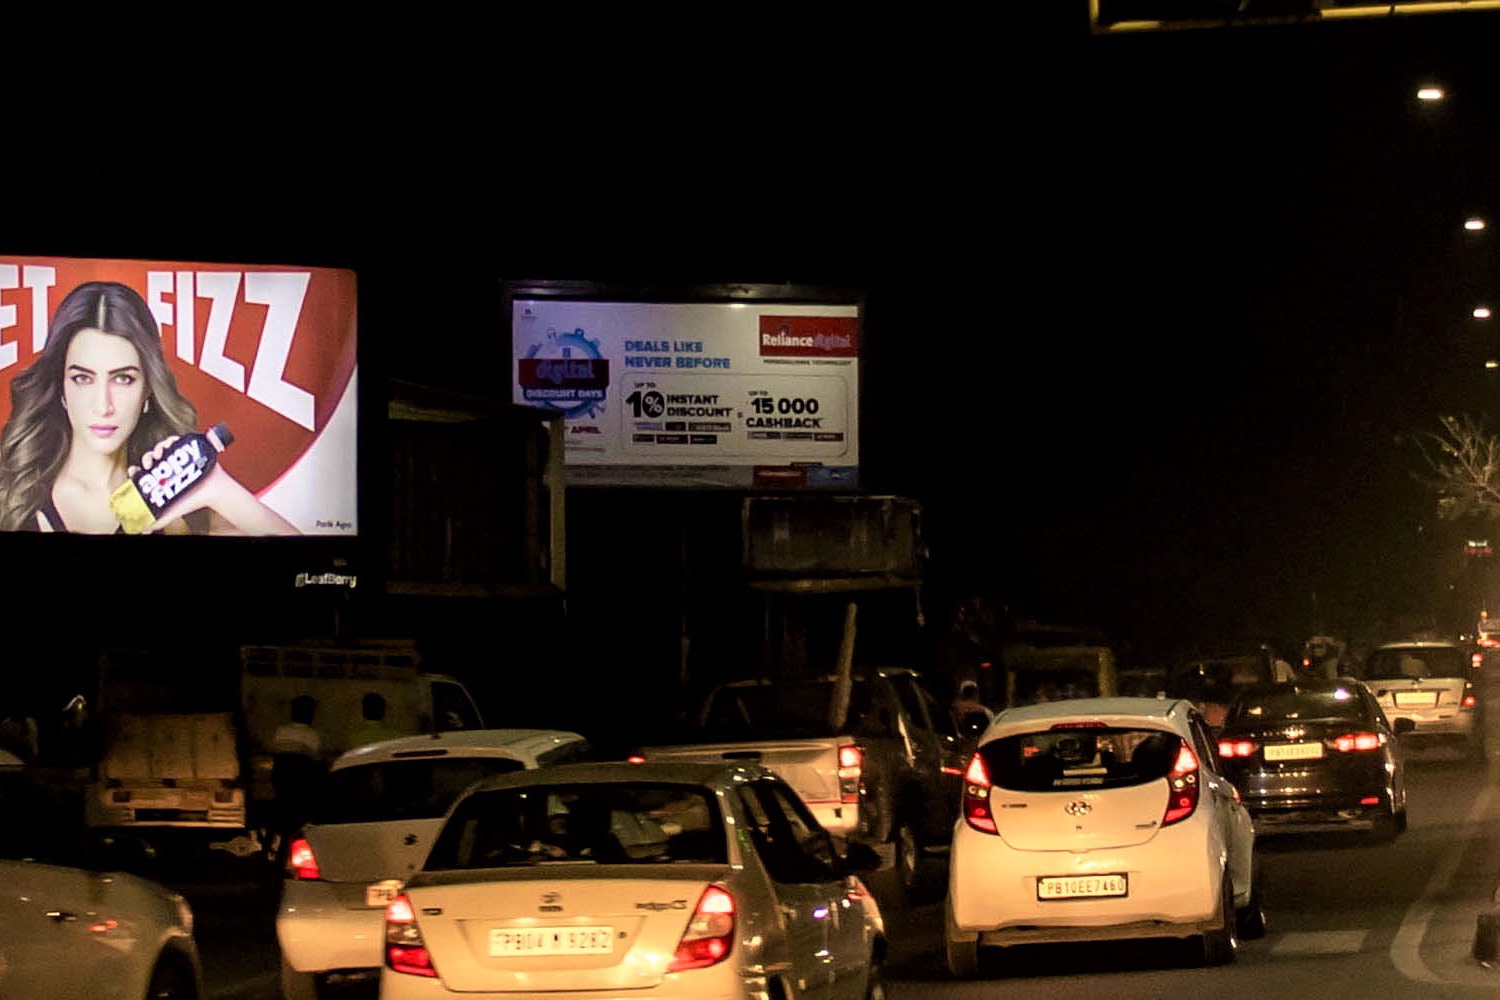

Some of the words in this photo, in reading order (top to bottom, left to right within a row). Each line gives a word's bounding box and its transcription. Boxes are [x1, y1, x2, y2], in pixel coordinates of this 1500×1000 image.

[146, 271, 316, 433] FIZZ
[625, 340, 670, 352] DEALS
[674, 341, 703, 352] LIKE
[625, 356, 672, 368] NEVER
[675, 357, 731, 369] BEFORE
[578, 389, 603, 398] DAYS
[667, 394, 719, 404] INSTANT
[139, 439, 202, 494] appy
